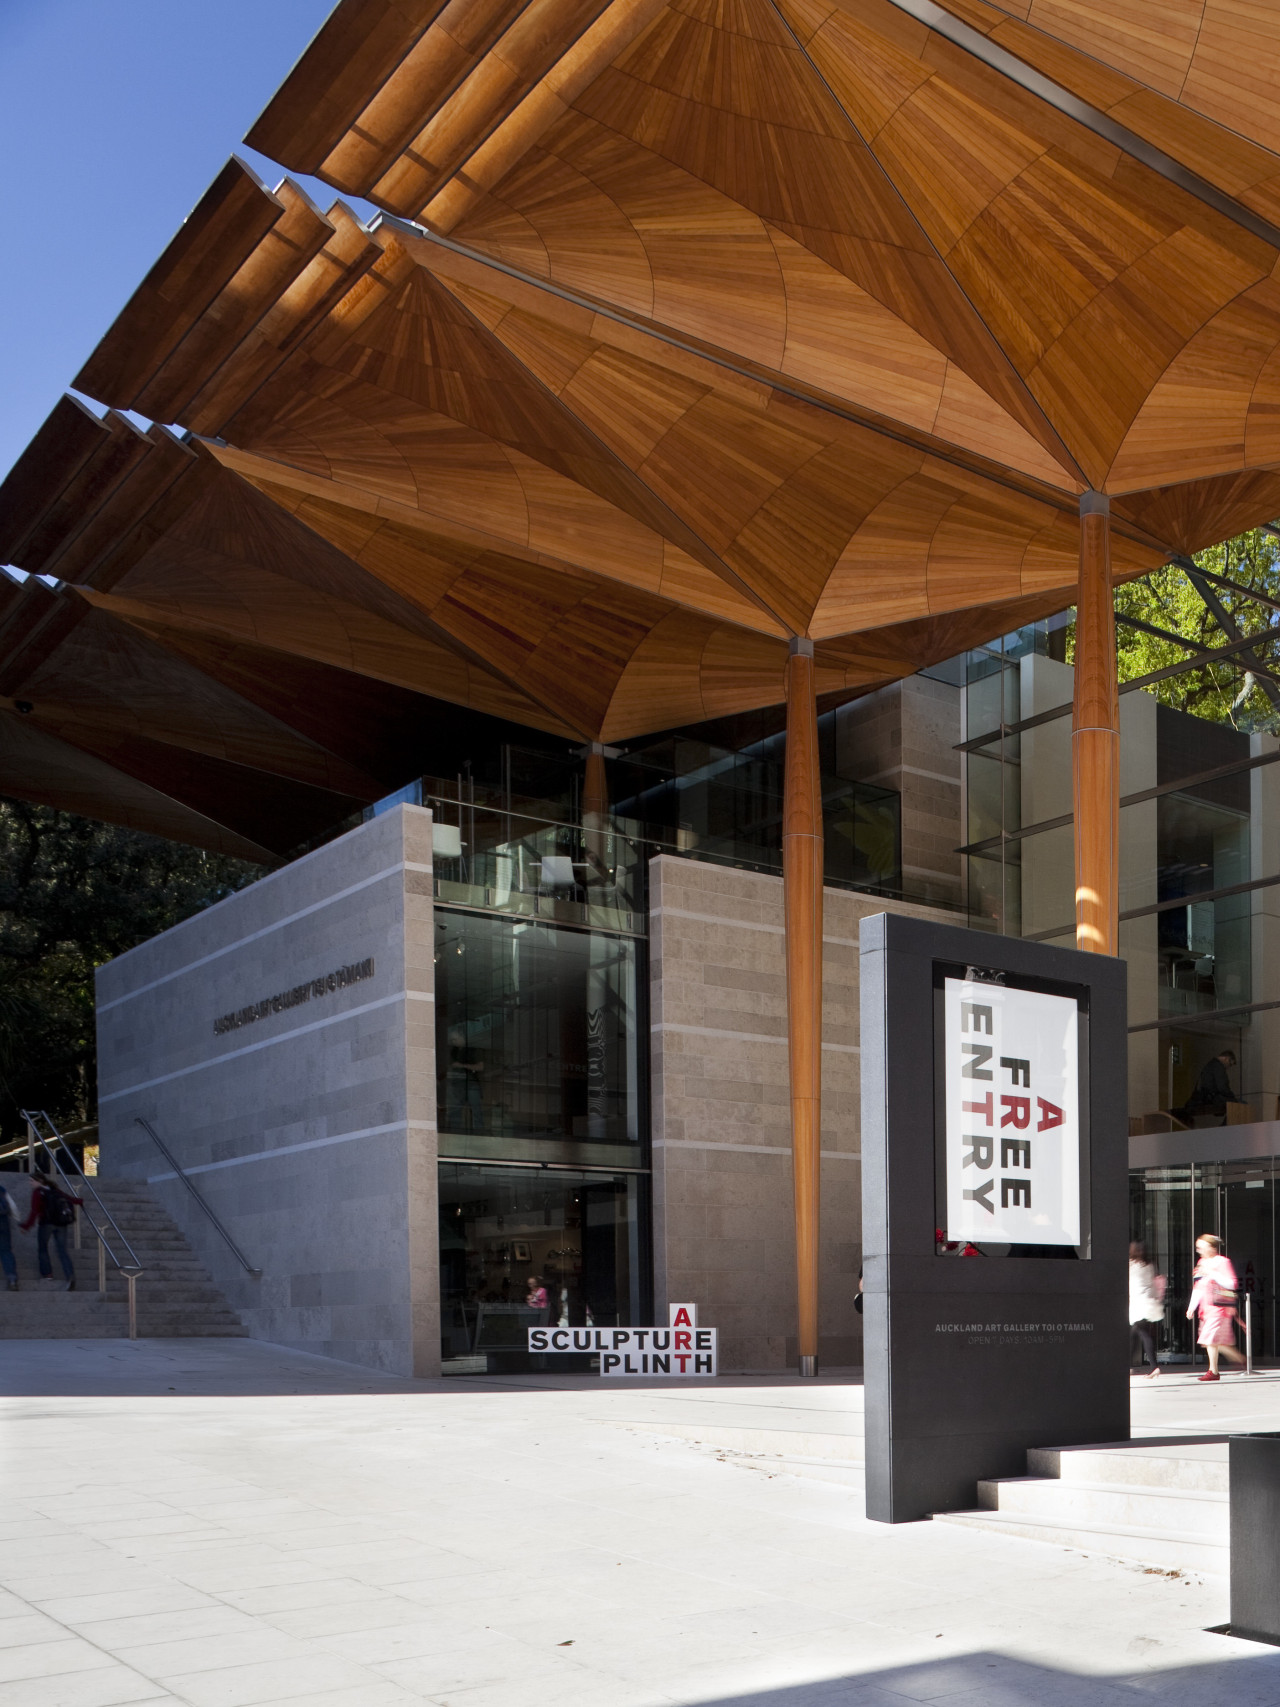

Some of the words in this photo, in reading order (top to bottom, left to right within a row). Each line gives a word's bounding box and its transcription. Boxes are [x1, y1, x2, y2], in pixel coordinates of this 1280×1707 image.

[960, 1001, 995, 1215] ENTRY
[1037, 1095, 1066, 1132] A
[1000, 1056, 1031, 1209] FREE
[935, 1323, 983, 1332] AUCKLAND
[984, 1323, 1001, 1332] ART
[1003, 1323, 1040, 1332] GALLERY
[1041, 1323, 1056, 1331] TOI
[1056, 1323, 1063, 1331] O
[530, 1330, 712, 1350] SCULPTURE
[967, 1336, 991, 1345] OPEN
[603, 1353, 712, 1374] PLINTH
